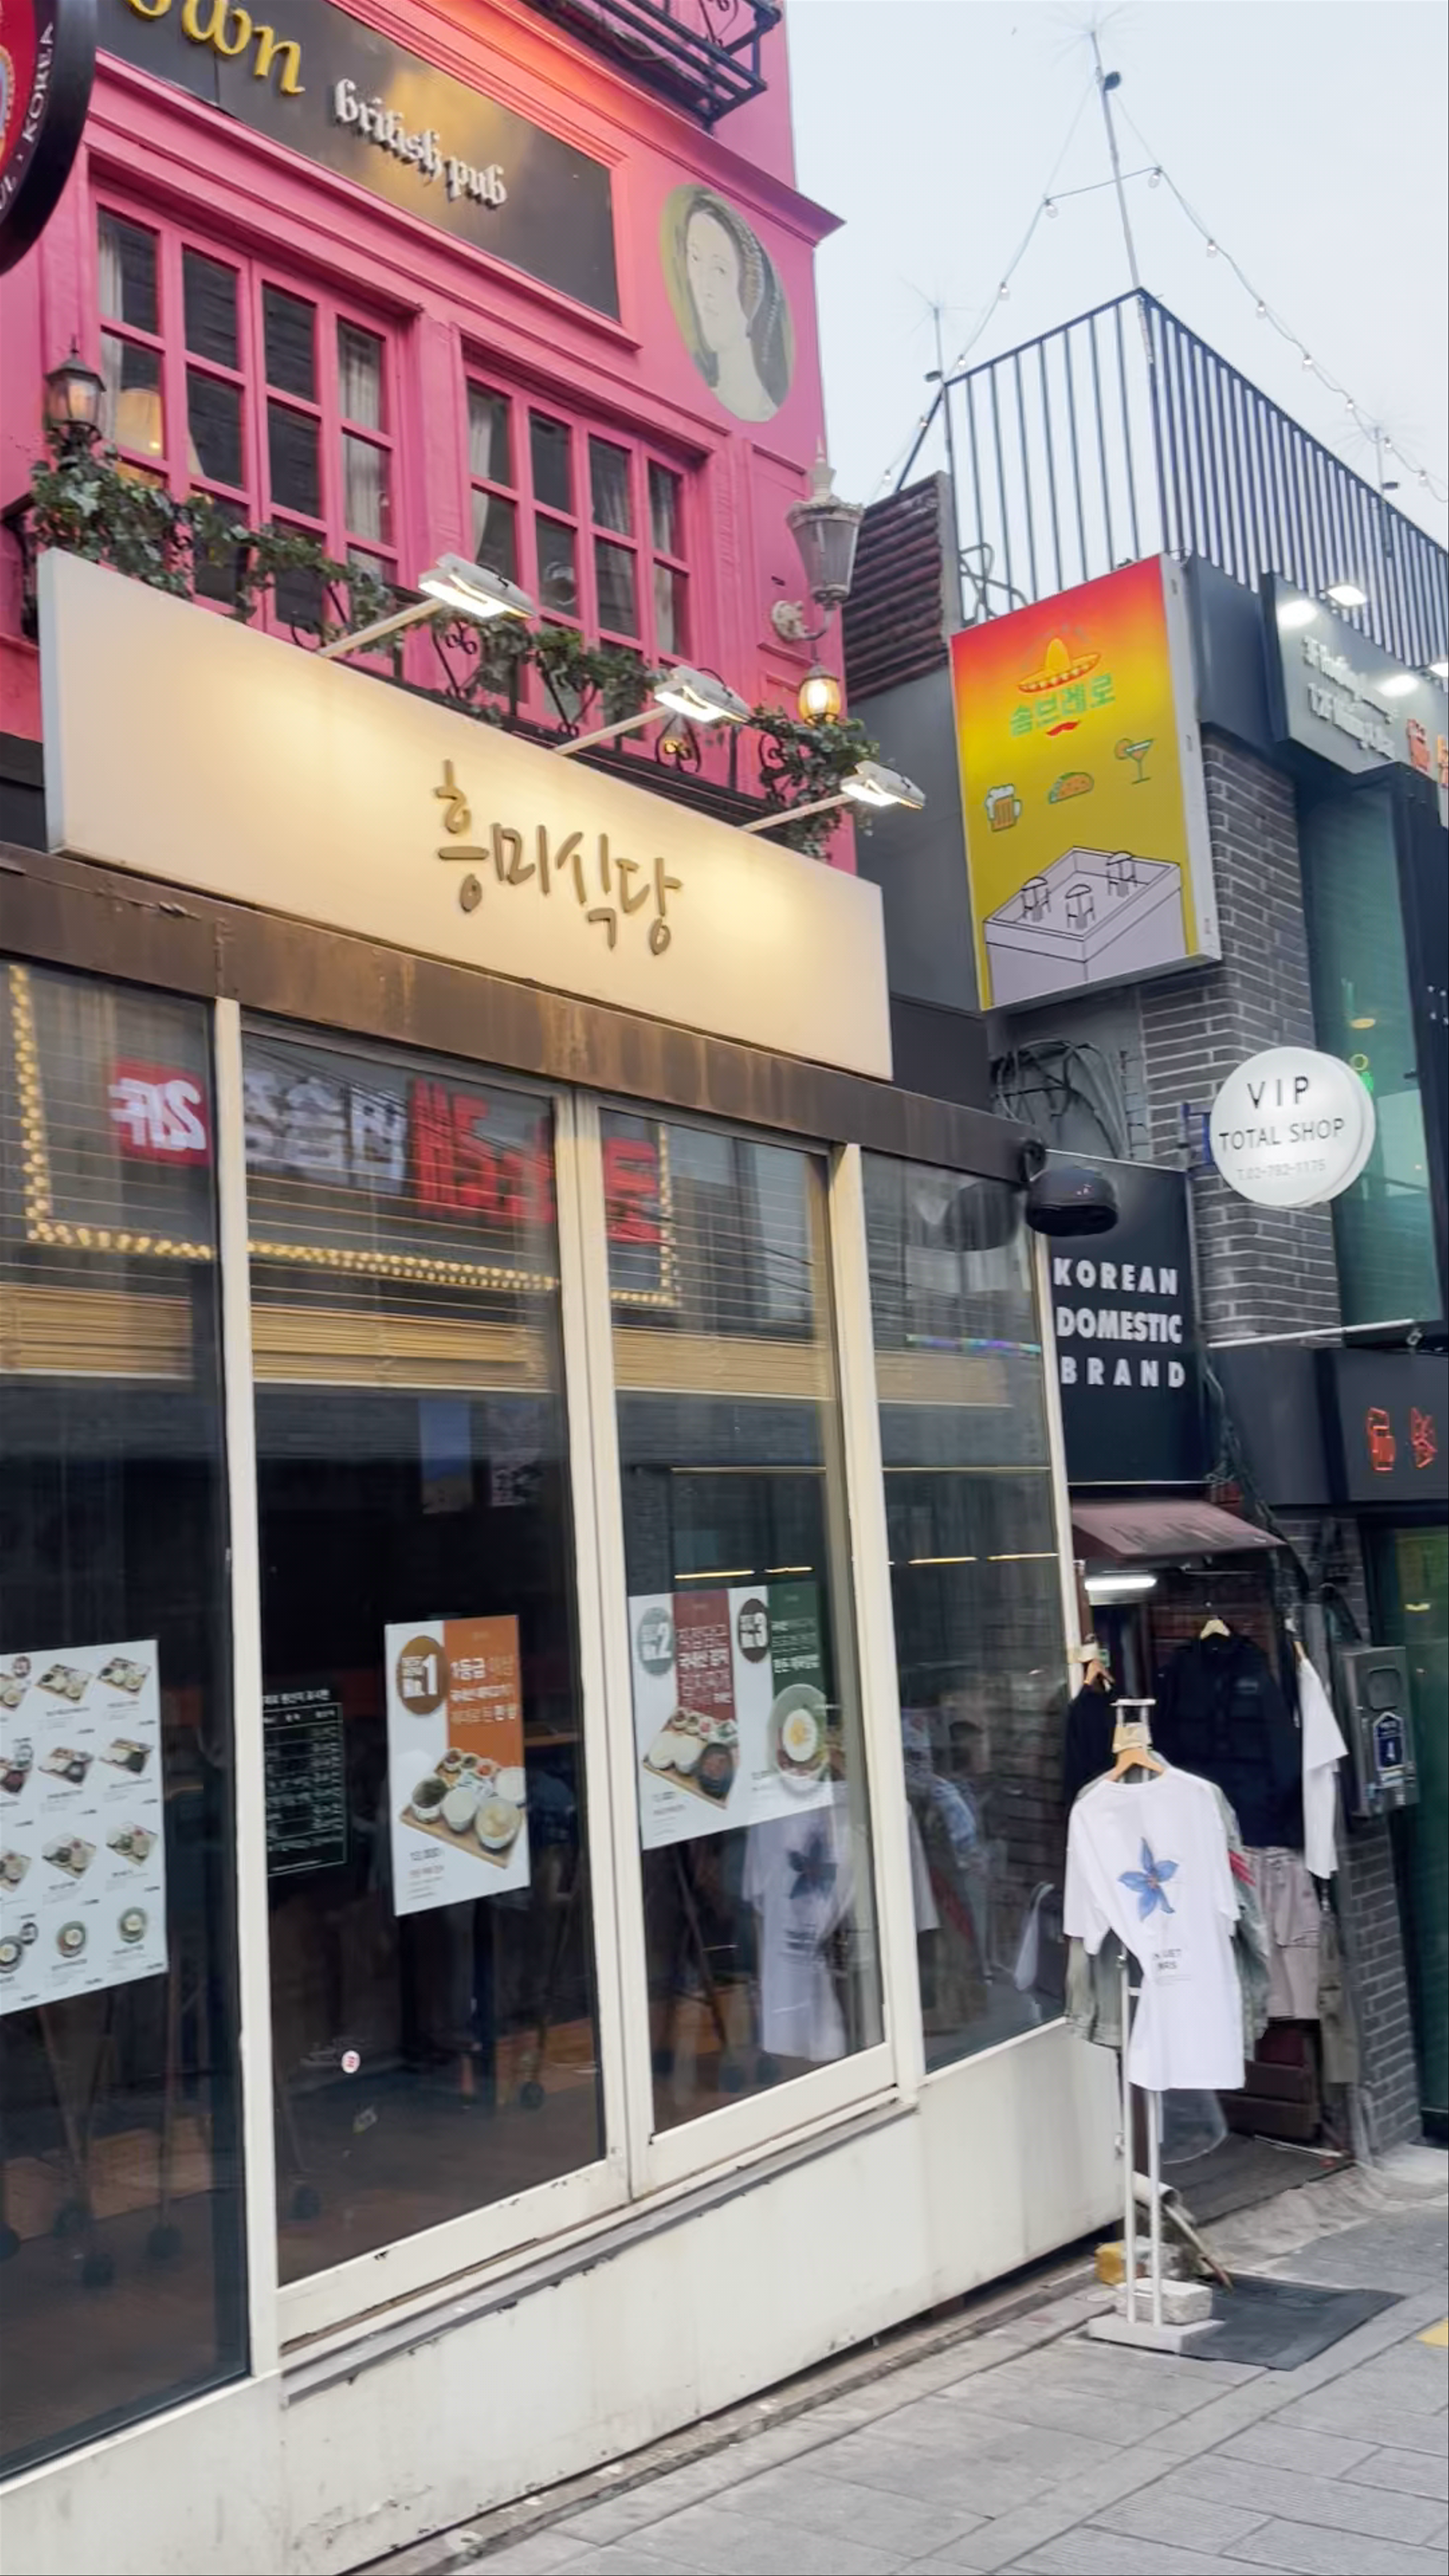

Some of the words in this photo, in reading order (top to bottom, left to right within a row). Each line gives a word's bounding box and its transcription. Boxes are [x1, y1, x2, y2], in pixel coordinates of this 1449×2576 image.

[22, 22, 54, 143] KOREA
[333, 78, 443, 180] british
[446, 157, 507, 208] pub
[433, 758, 683, 956] 흥미식당
[1247, 1075, 1309, 1109] VIP
[1218, 1126, 1281, 1152] TOTAL
[1289, 1117, 1344, 1144] SHOP
[1053, 1257, 1178, 1296] KOREAN
[1056, 1306, 1183, 1344] DOMESTIC
[1060, 1356, 1186, 1388] BRAND
